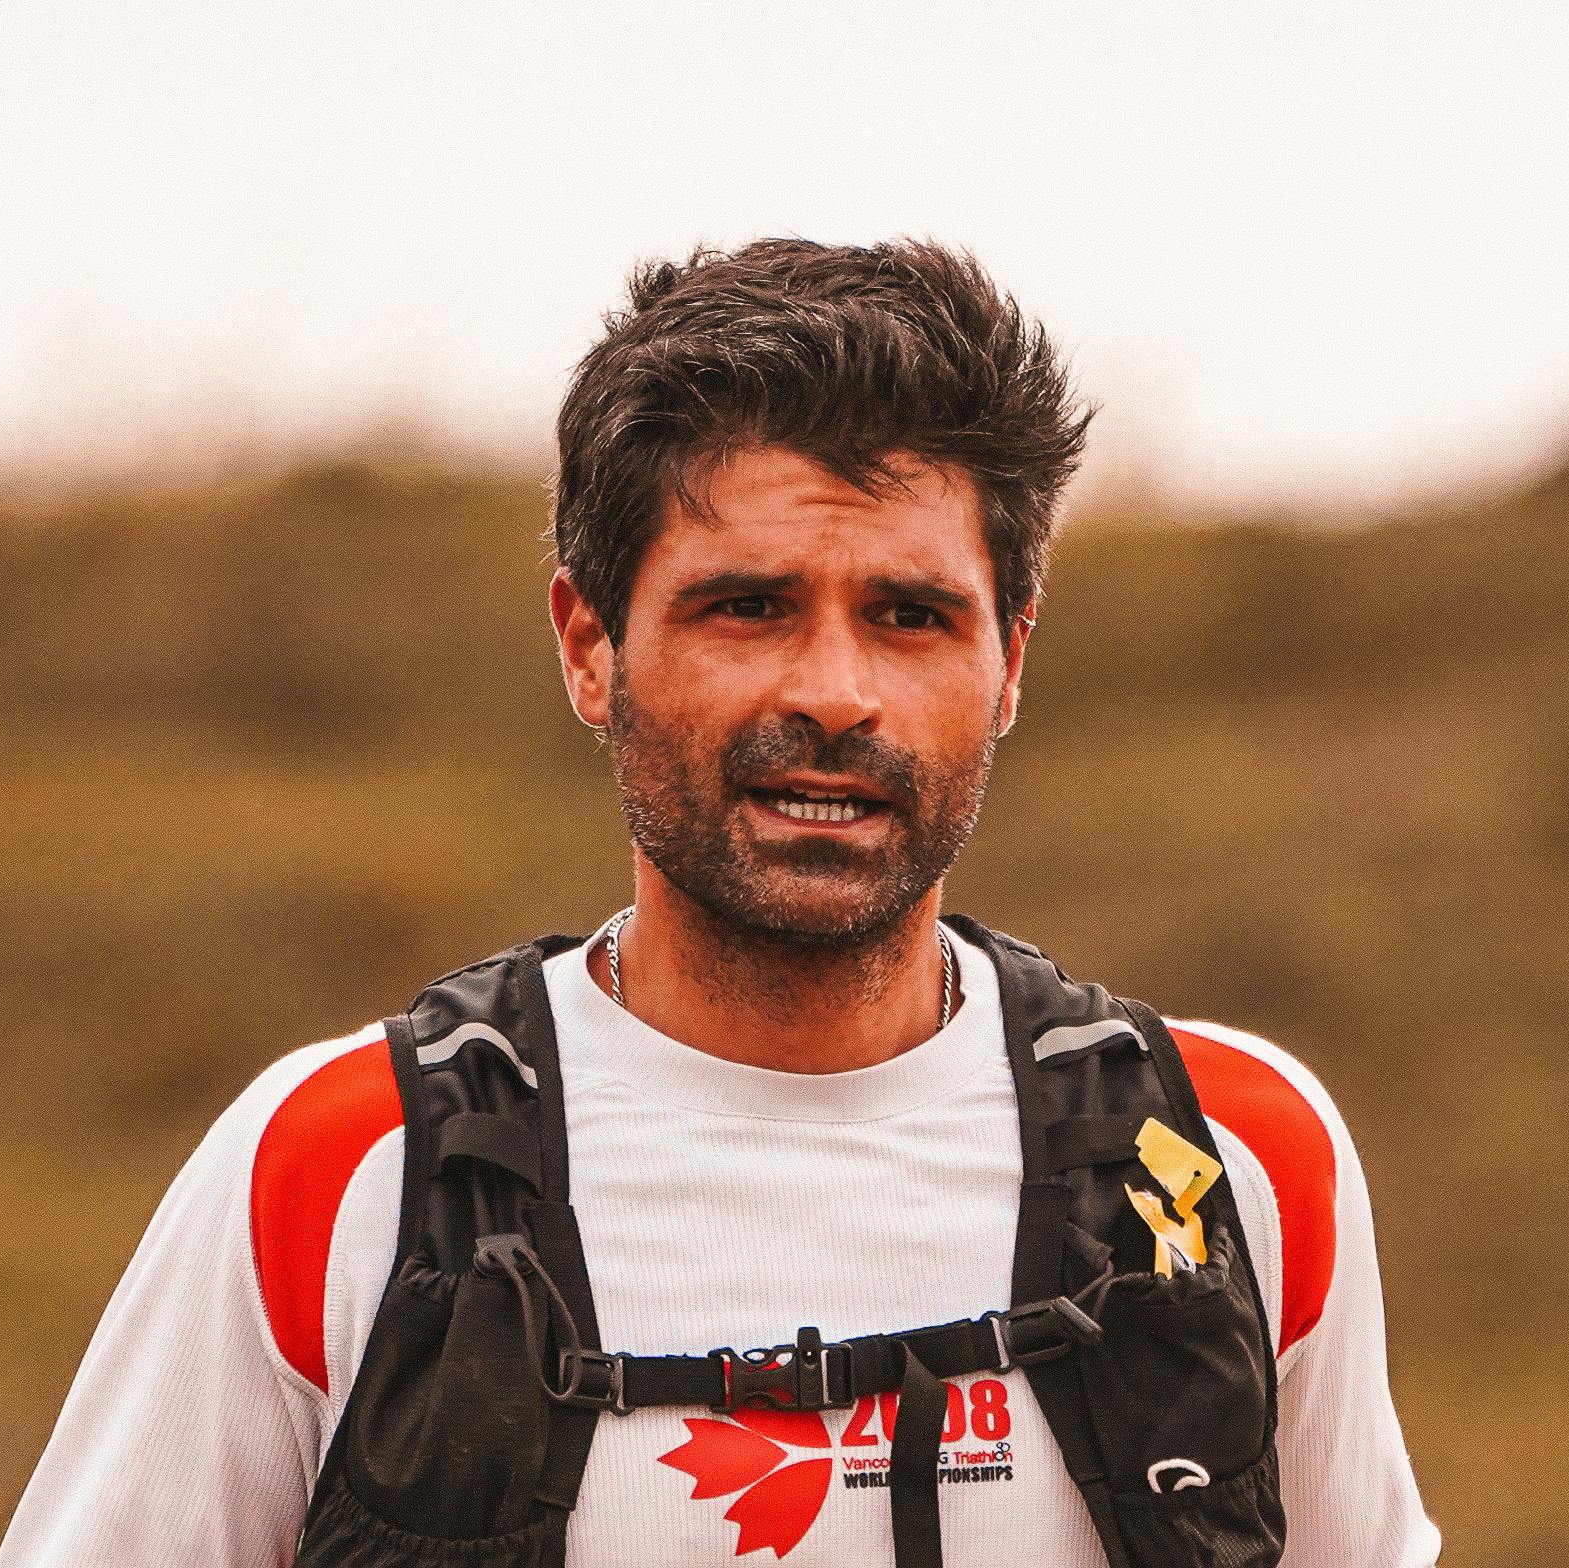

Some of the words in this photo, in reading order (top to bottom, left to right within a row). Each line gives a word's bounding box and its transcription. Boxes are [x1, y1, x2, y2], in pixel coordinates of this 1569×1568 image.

[842, 1456, 890, 1470] Vanco
[953, 1450, 1013, 1465] Triathlon
[939, 1466, 1013, 1483] PIONSHIPS
